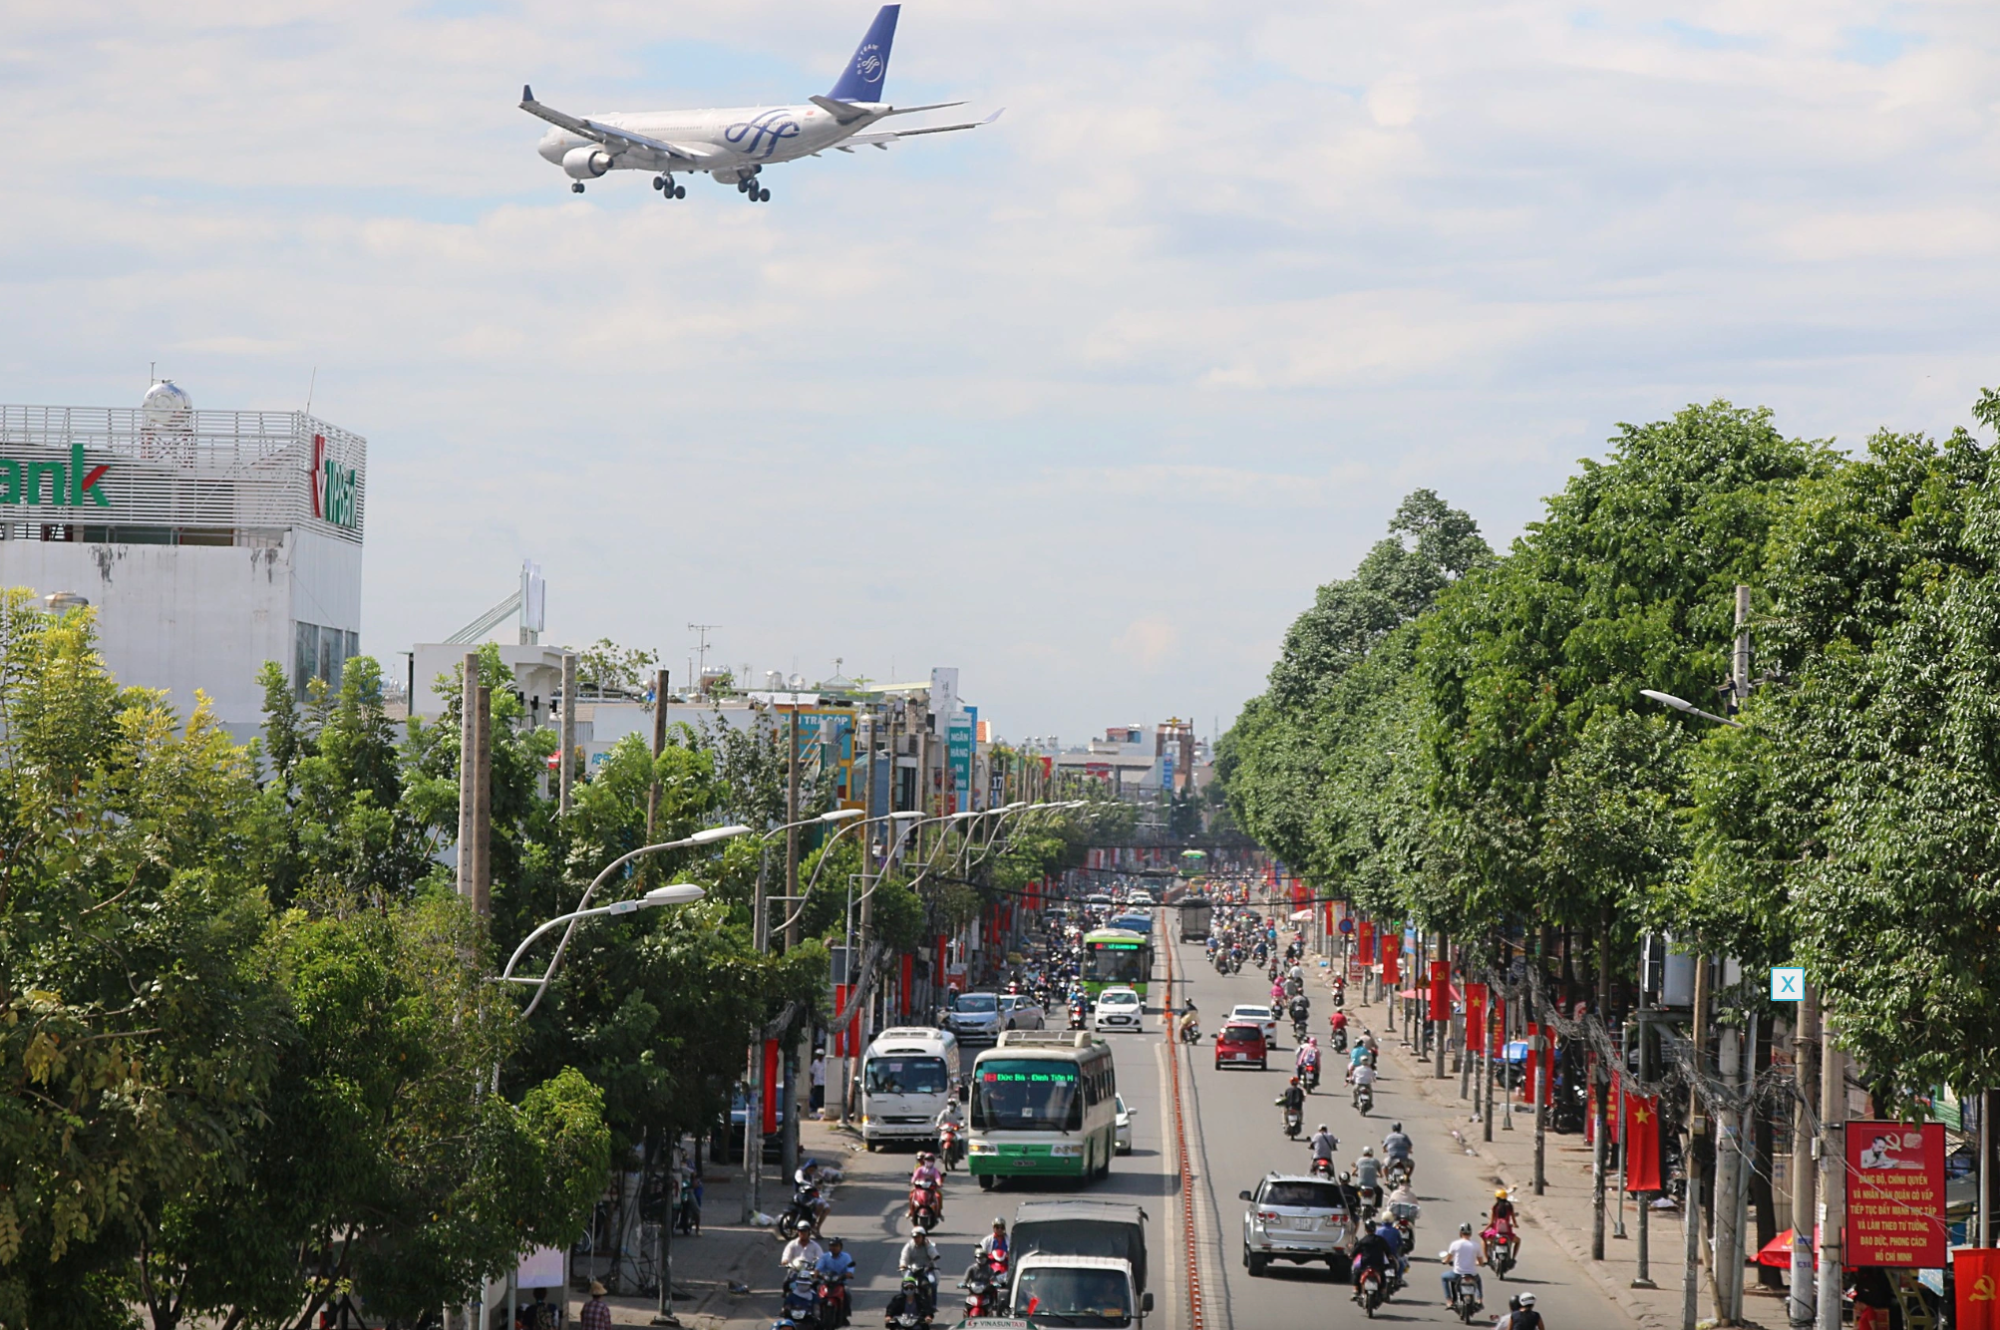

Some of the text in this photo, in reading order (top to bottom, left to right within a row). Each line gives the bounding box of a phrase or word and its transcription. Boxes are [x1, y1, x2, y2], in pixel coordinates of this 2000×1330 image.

[950, 748, 968, 758] HÀNG
[1853, 1188, 1861, 1199] VÀ
[1858, 1220, 1865, 1230] VÀ
[1882, 1221, 1897, 1230] THEO
[1890, 1237, 1909, 1246] PHONG
[1911, 1236, 1927, 1246] CÁCH
[1875, 1250, 1912, 1261] HỒ CHÍ MINH
